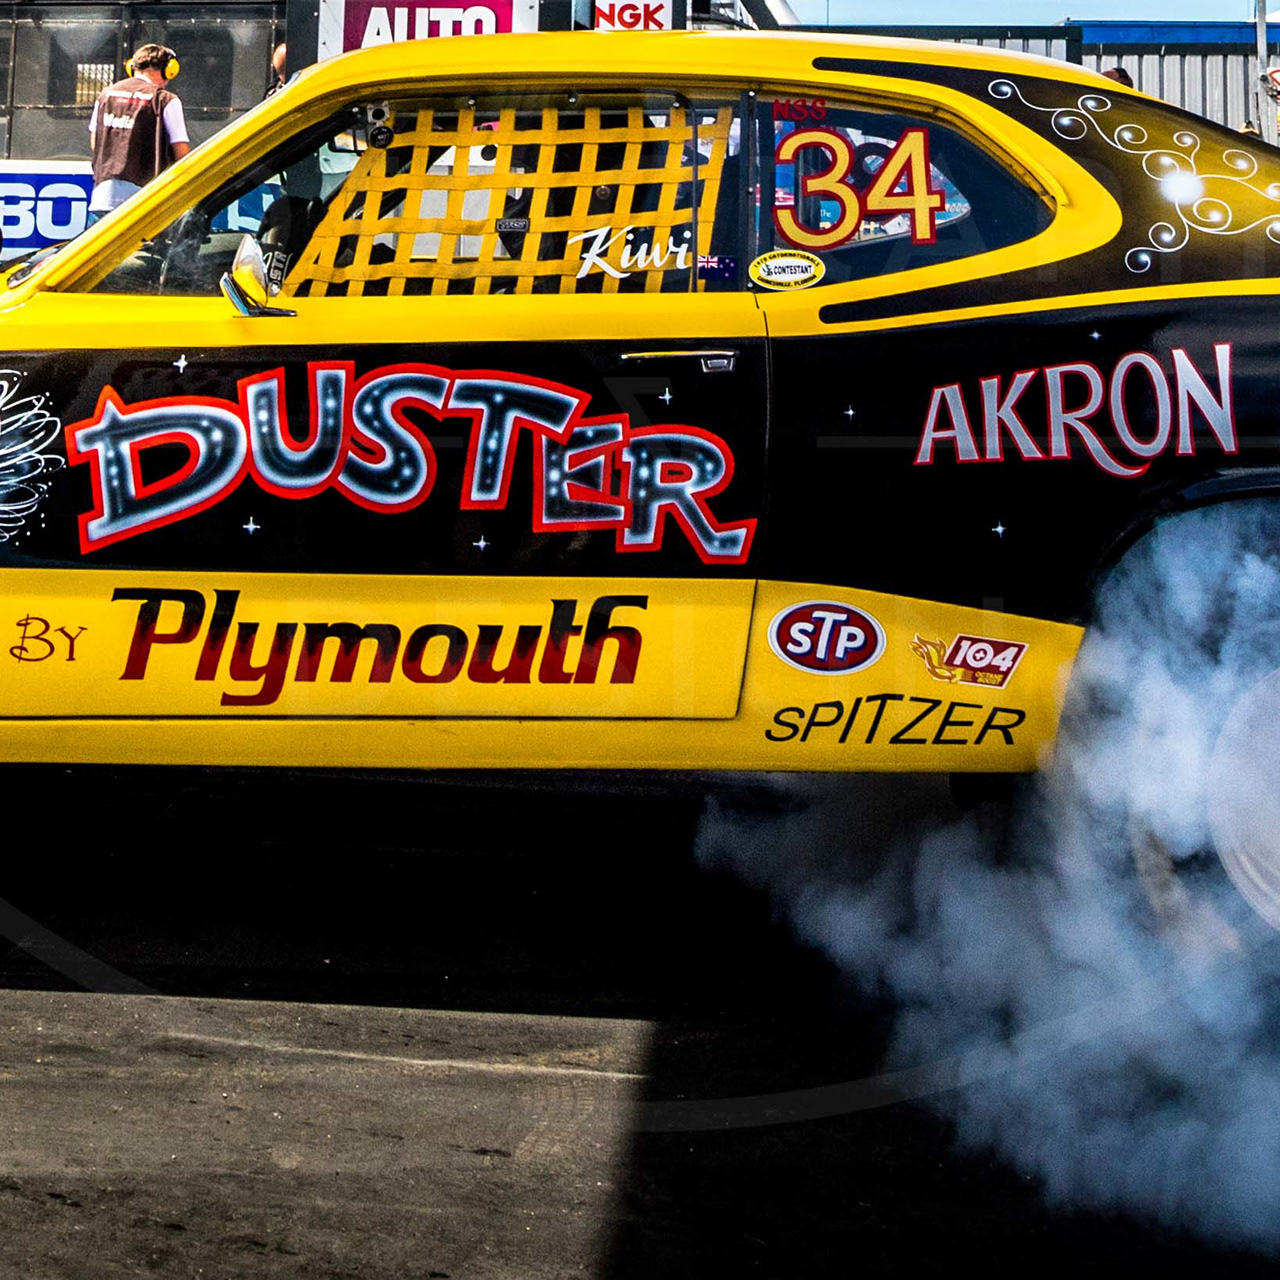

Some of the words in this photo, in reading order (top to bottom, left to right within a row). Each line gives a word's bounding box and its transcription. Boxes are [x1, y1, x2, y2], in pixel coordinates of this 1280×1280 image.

[595, 3, 665, 30] NGK
[773, 127, 946, 252] 34
[567, 224, 693, 279] Kiwi
[773, 264, 812, 275] CONTESTANT
[914, 342, 1239, 478] AKRON
[65, 360, 758, 566] DUSTER
[9, 613, 90, 666] BY
[111, 586, 648, 708] Plymouth
[786, 610, 867, 662] STP
[953, 639, 1020, 672] 104
[764, 693, 1027, 746] SPITZER
